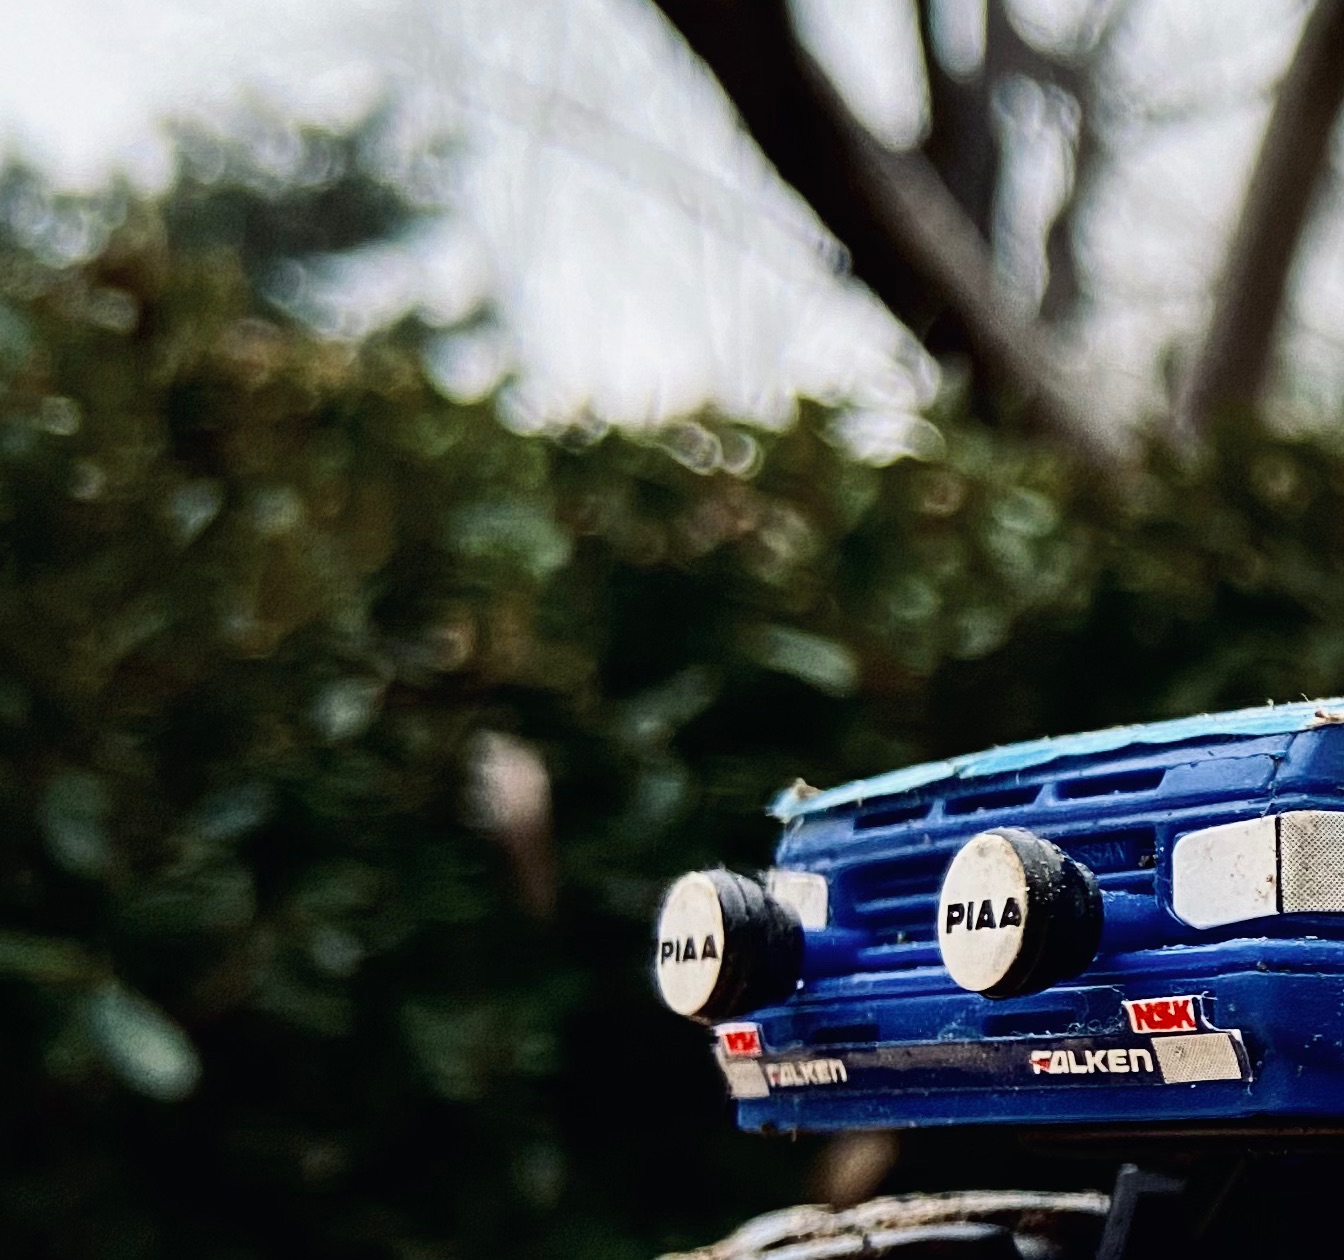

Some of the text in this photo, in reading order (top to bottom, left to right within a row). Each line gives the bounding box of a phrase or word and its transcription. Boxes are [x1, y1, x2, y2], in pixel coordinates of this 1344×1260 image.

[946, 898, 1023, 935] PIAA
[660, 934, 719, 964] PIAA
[1132, 1000, 1197, 1031] NSK
[766, 1058, 848, 1088] FALKEN
[1029, 1048, 1154, 1074] FALKEN
